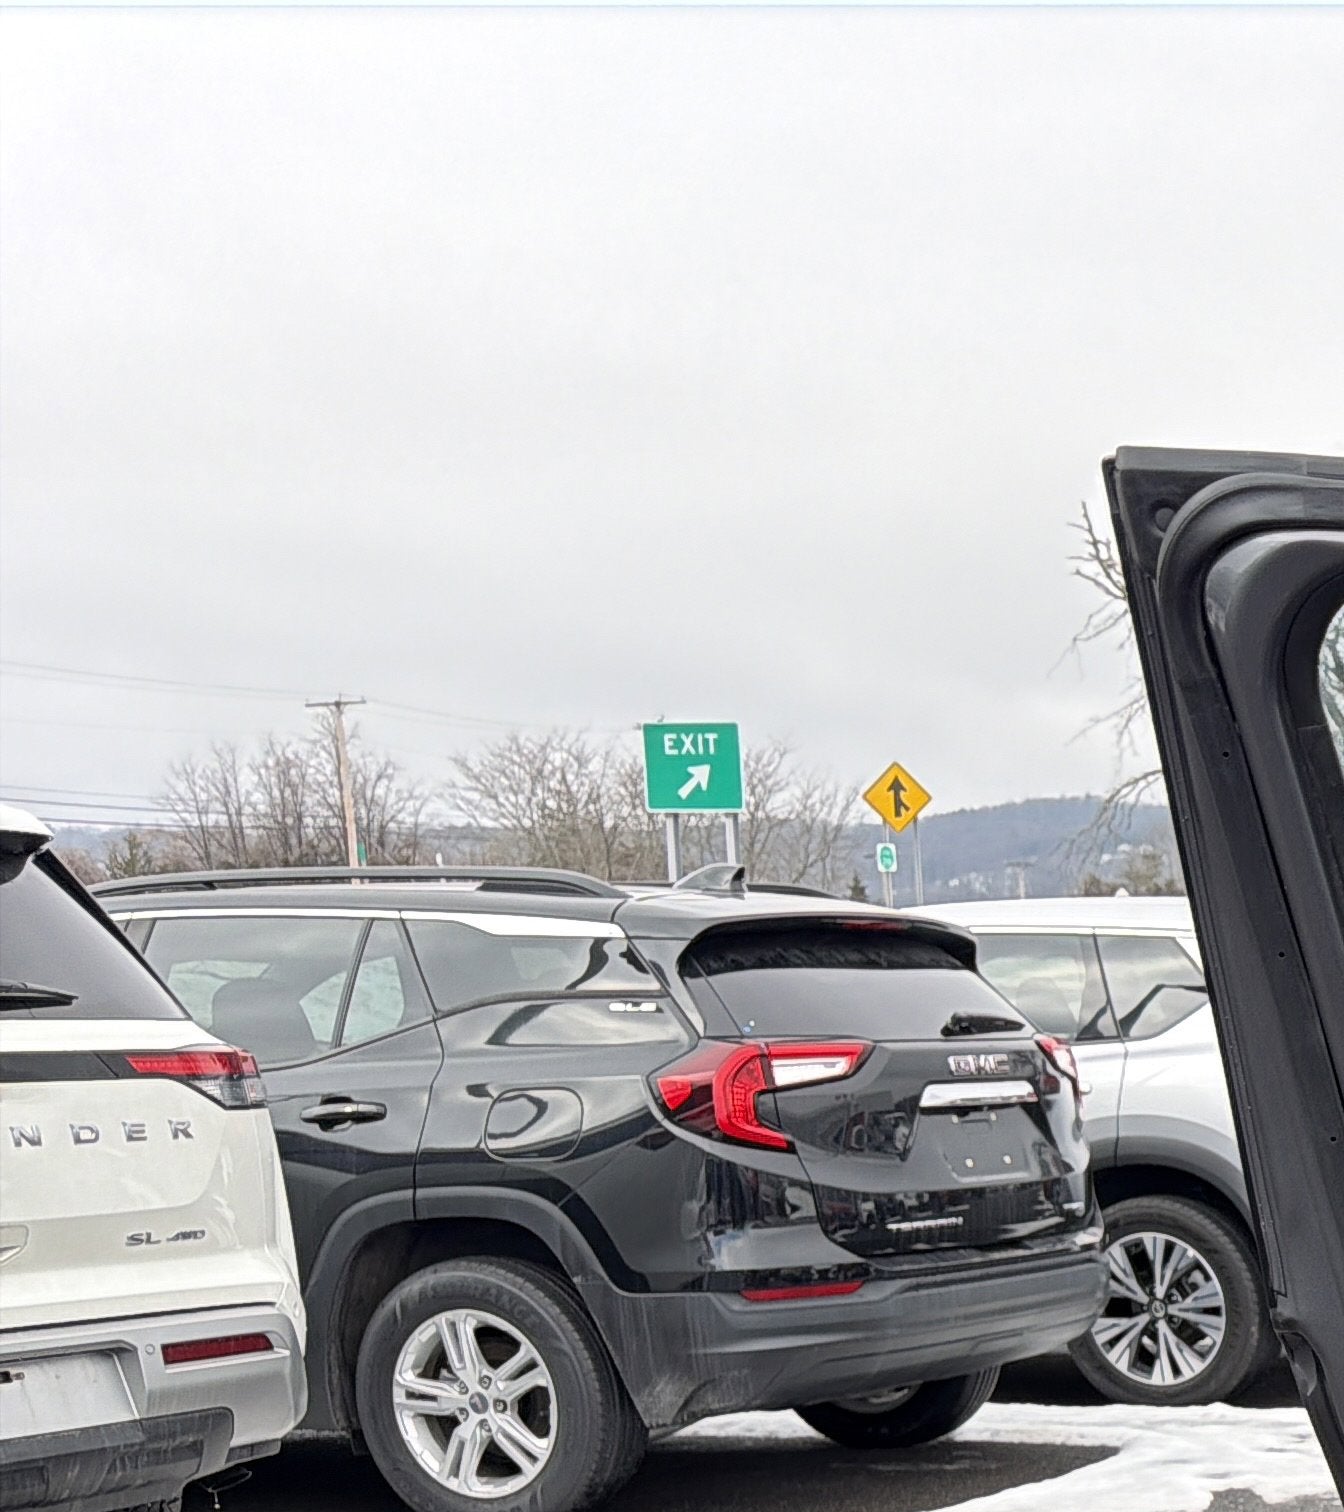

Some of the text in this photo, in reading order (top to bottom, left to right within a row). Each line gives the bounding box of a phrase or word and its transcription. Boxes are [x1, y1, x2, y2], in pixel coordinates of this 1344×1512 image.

[663, 732, 719, 755] EXIT
[947, 1053, 1010, 1076] GMC
[125, 1232, 162, 1246] SL
